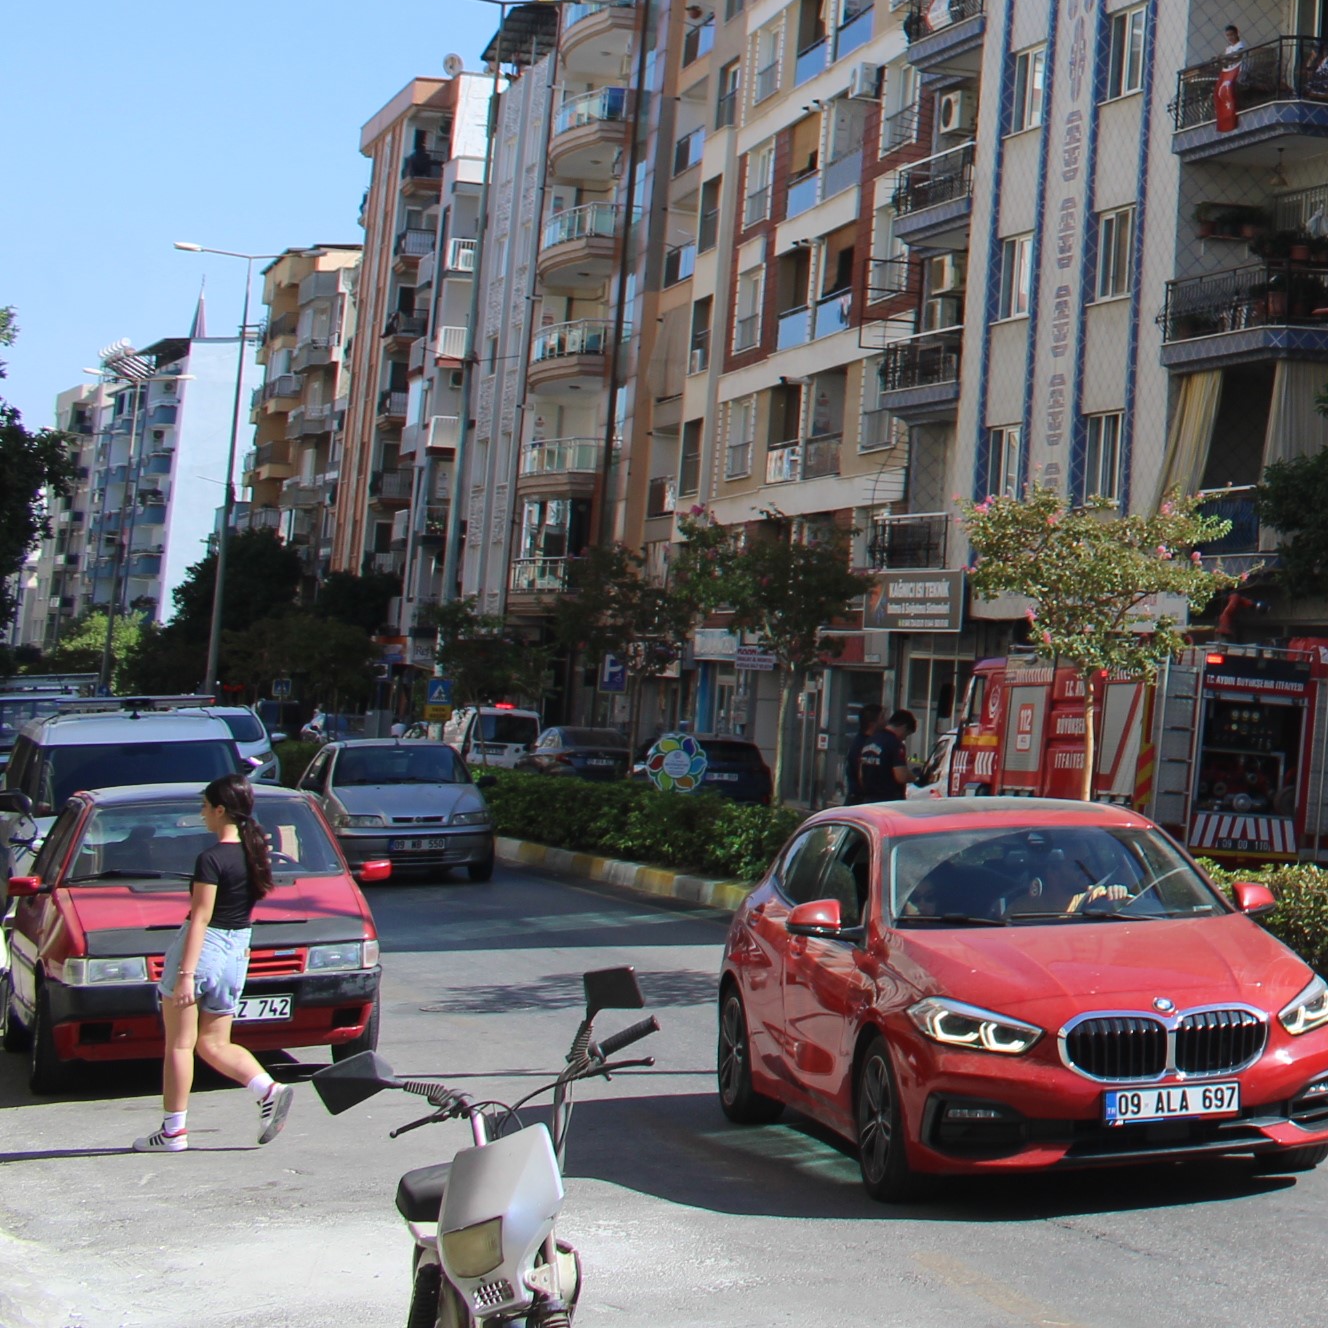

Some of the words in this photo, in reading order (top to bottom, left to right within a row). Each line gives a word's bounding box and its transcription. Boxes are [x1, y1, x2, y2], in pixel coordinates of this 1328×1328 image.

[1019, 709, 1032, 731] 112
[1054, 751, 1085, 769] İTFAİYES
[394, 839, 405, 850] 09
[428, 838, 444, 849] 550
[233, 1000, 249, 1018] Z
[258, 998, 290, 1018] 742
[1117, 1092, 1142, 1116] 09
[1154, 1089, 1189, 1115] ALA
[1201, 1085, 1237, 1110] 697
